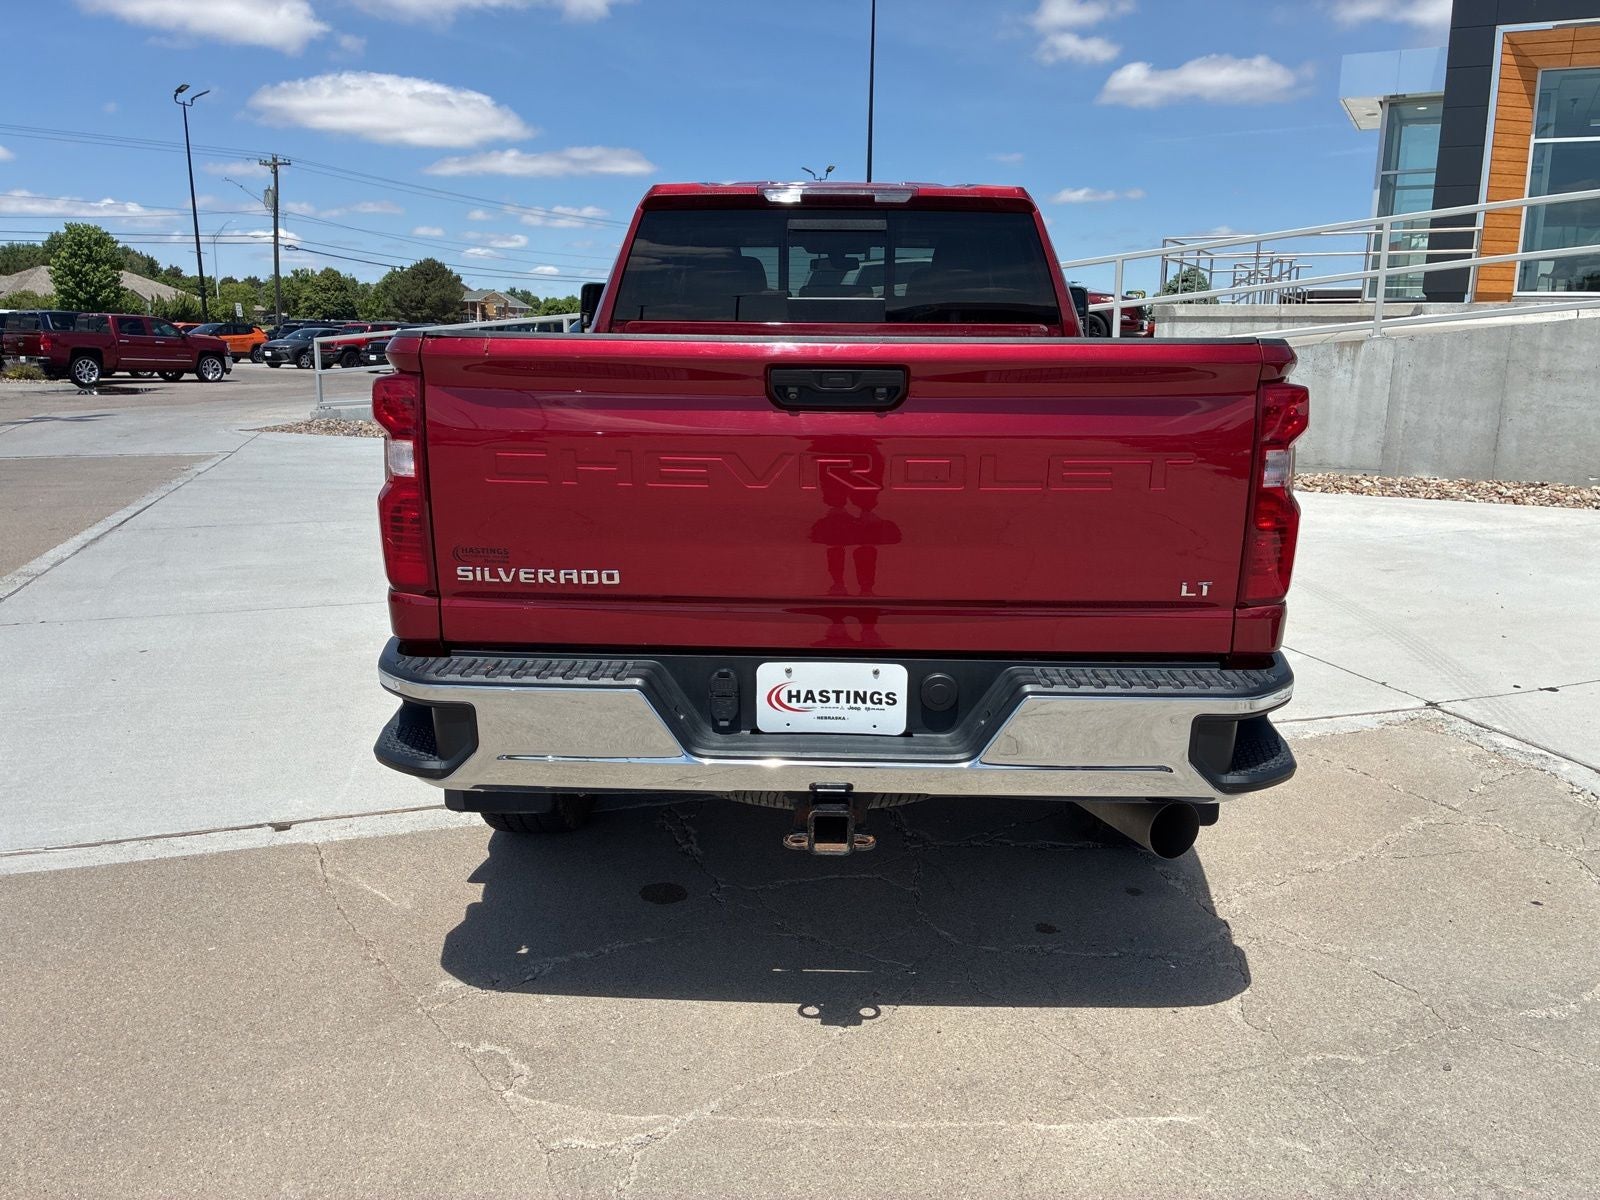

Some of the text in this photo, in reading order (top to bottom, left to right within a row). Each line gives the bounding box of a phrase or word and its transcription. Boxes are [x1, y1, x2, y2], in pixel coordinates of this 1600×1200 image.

[485, 448, 1197, 491] CHEVROLET
[461, 547, 510, 556] HASTINGS
[456, 566, 621, 585] SILVERADO
[1181, 581, 1213, 597] LT
[786, 689, 898, 707] HASTINGS
